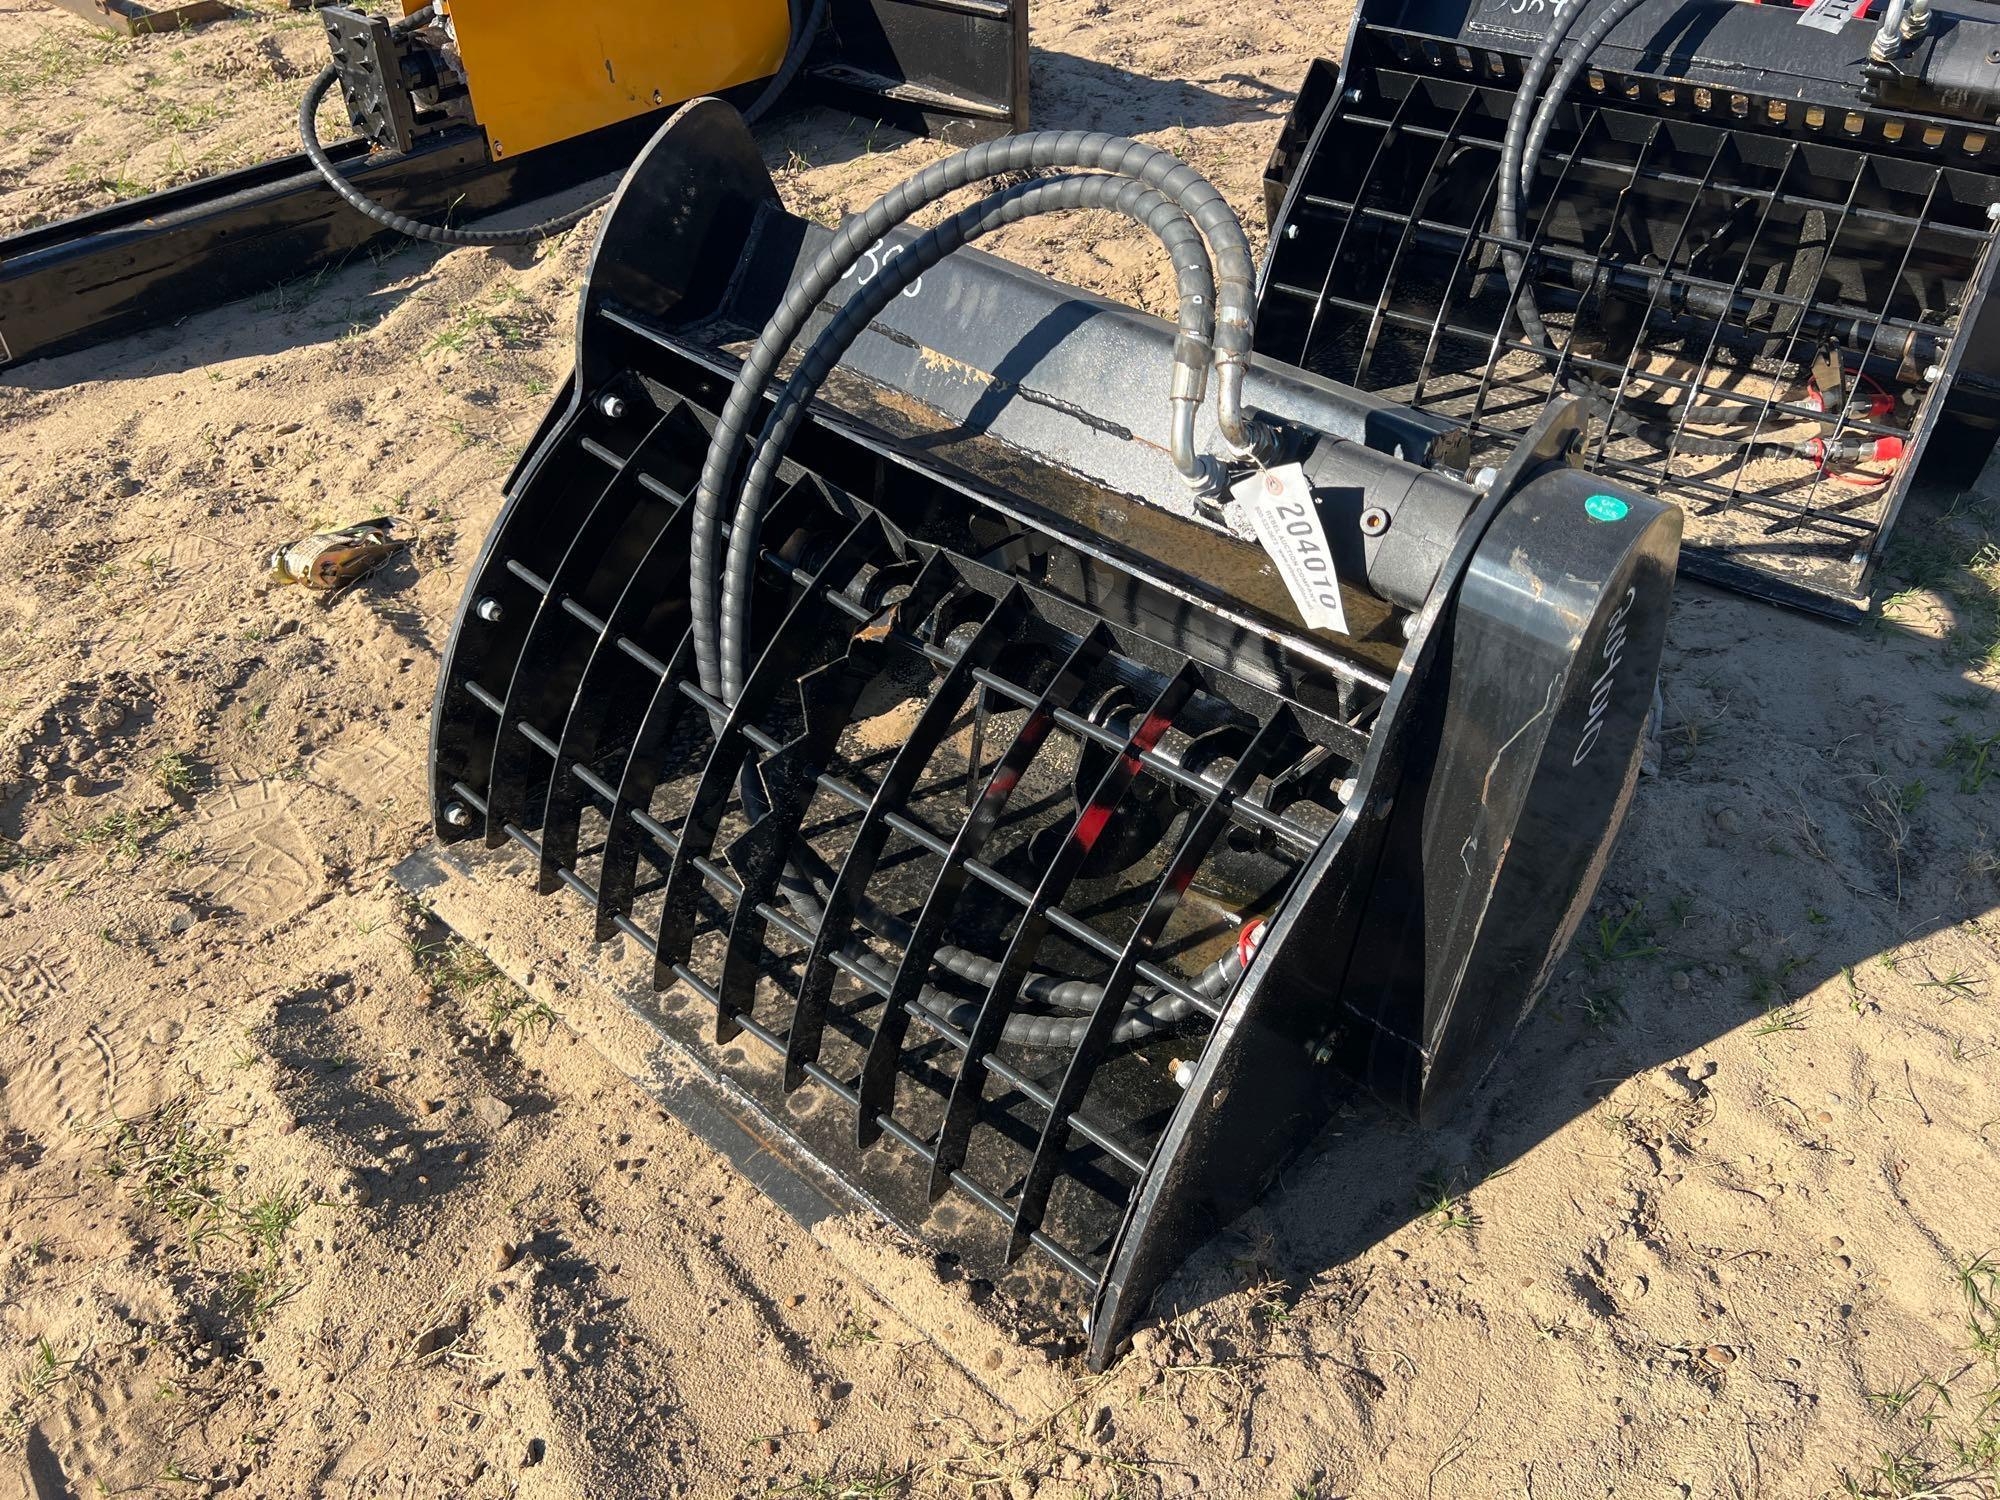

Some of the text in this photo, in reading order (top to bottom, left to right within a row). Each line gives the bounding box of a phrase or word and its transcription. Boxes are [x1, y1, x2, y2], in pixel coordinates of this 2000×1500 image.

[1264, 508, 1317, 603] REBEL AUCTION COMPANY
[1275, 502, 1337, 610] 204010
[1571, 586, 1636, 767] 204010
